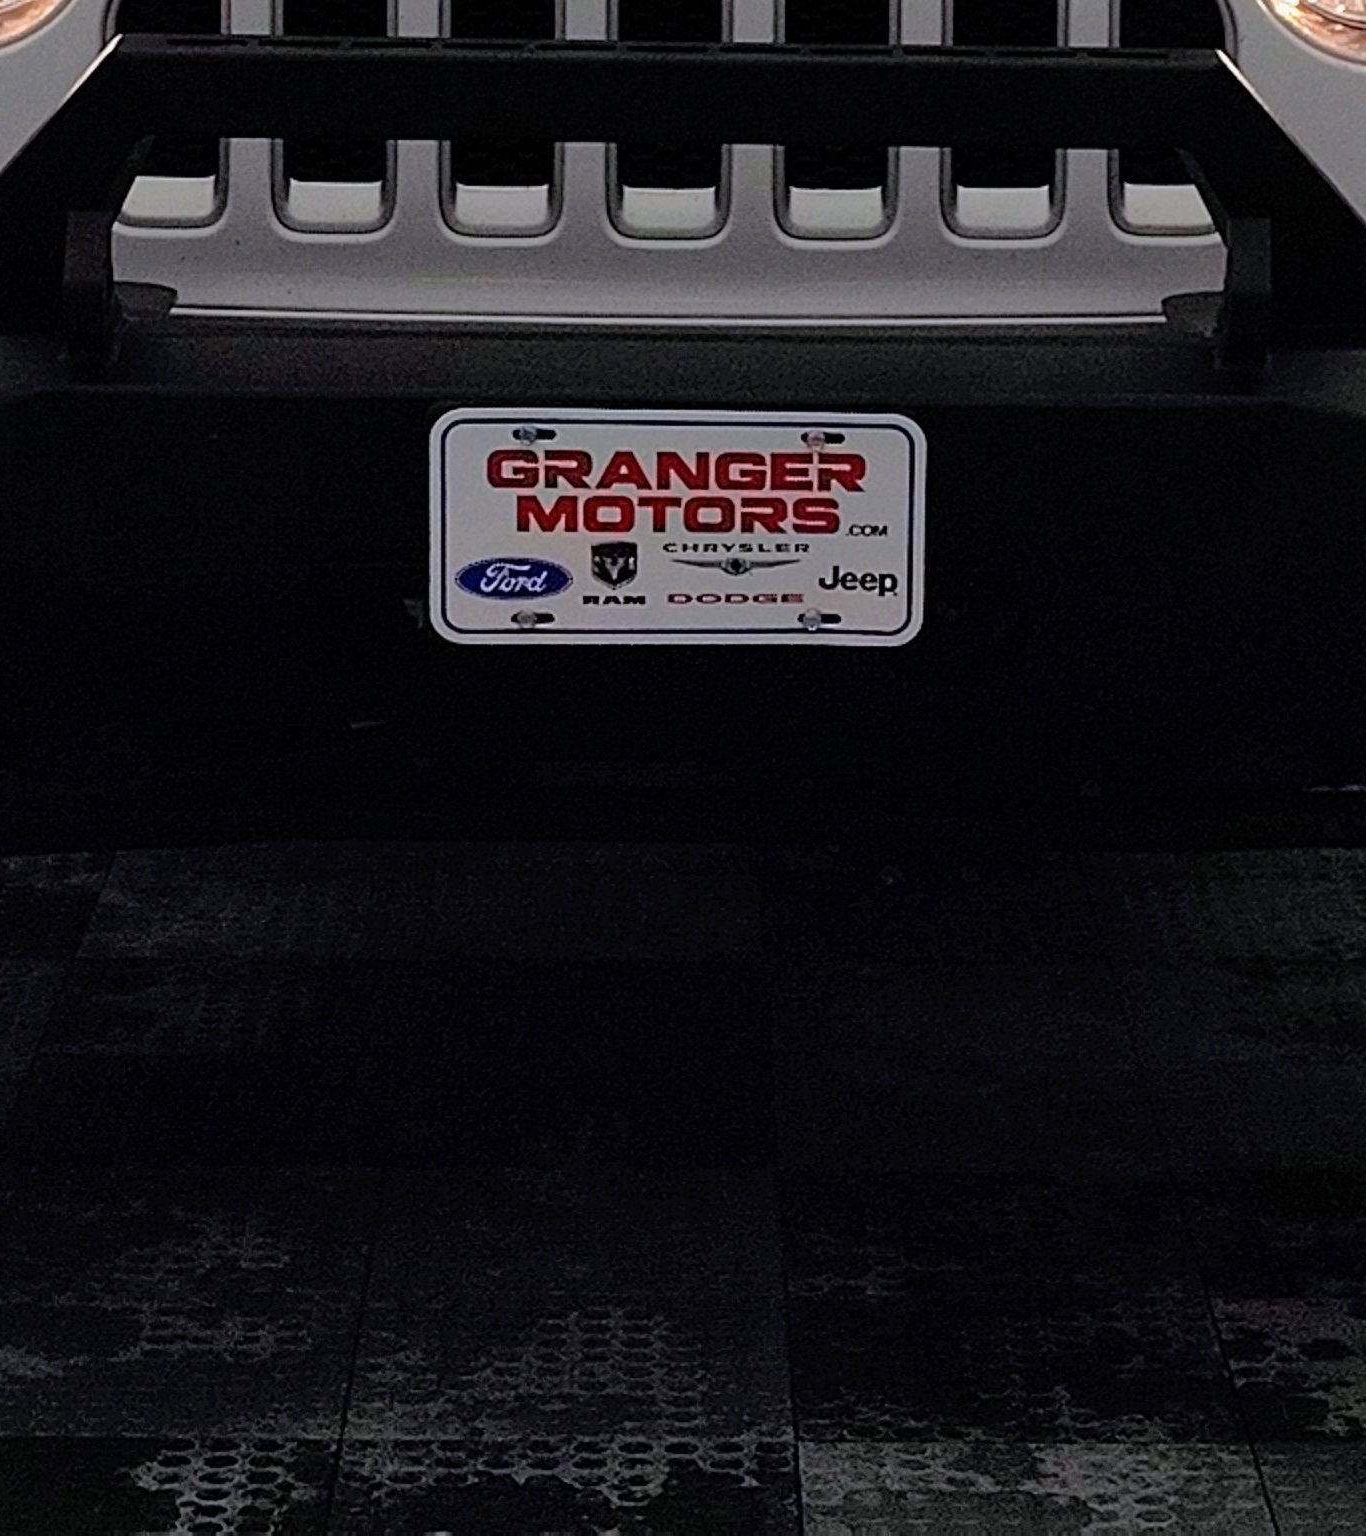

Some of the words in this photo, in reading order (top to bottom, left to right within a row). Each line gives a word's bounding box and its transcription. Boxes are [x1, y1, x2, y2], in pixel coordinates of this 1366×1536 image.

[486, 449, 866, 492] GRANGER
[516, 495, 840, 534] MOTORS
[662, 543, 810, 553] CHRYSLER
[479, 562, 548, 592] Ford
[818, 565, 898, 596] Jeep
[582, 595, 646, 605] RAM
[667, 593, 804, 603] DODGE
